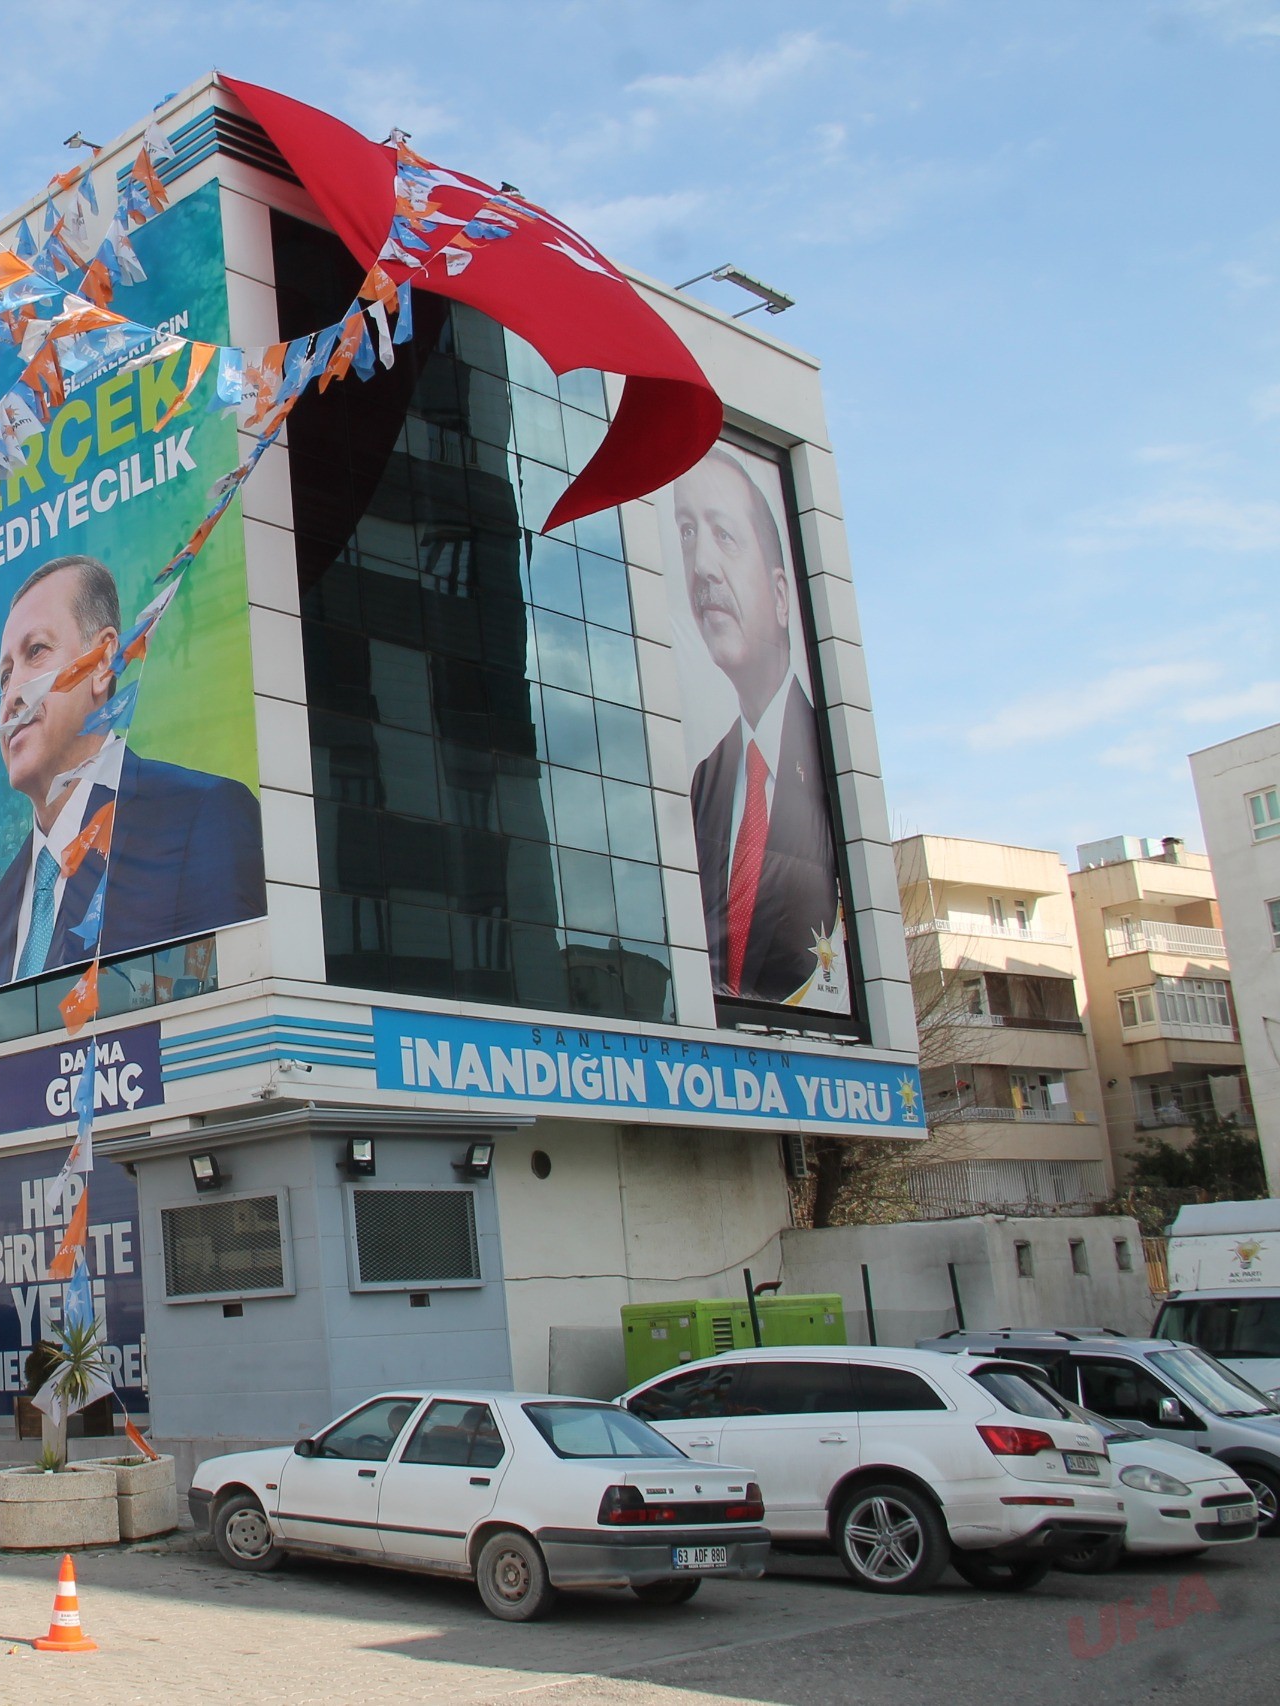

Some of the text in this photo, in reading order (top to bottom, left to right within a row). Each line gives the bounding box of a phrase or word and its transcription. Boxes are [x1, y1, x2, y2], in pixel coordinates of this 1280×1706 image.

[60, 1041, 125, 1074] DAMA
[532, 1028, 791, 1068] ŞANLIURFA İÇİN
[400, 1036, 892, 1122] İNANDIĞIN YOLDA YÜRÜ
[21, 1174, 85, 1230] HEP
[11, 1278, 108, 1347] YEİ
[678, 1549, 688, 1563] 63
[694, 1548, 708, 1563] ADF
